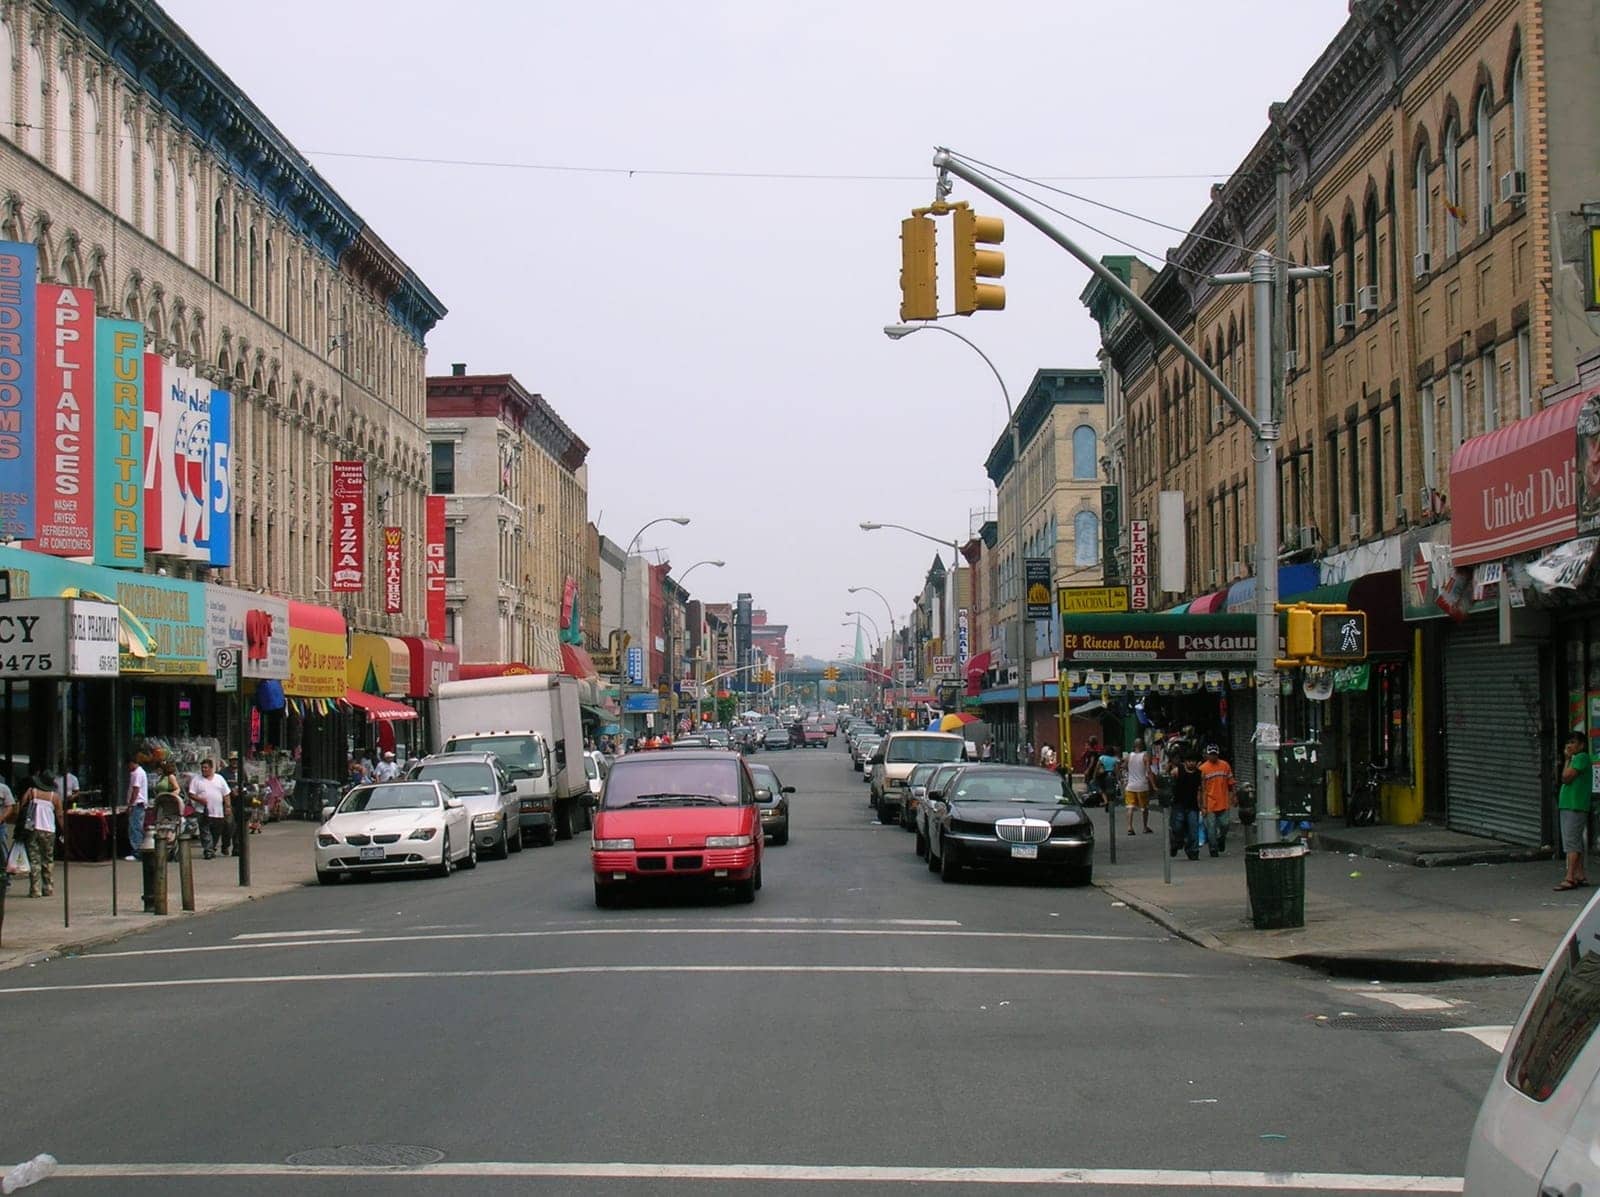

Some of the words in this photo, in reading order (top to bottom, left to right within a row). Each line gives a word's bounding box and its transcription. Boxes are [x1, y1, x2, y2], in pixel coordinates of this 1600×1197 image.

[55, 288, 80, 495] APPLIANCES
[113, 331, 139, 559] FURNITURE
[1482, 473, 1535, 531] United
[1540, 456, 1576, 514] Deli
[41, 525, 89, 538] REFRIGERATORS
[338, 502, 358, 567] PIZZA
[387, 551, 401, 609] KITCHEN
[427, 544, 445, 591] GNC
[1132, 522, 1146, 609] LLAMADAS
[1065, 635, 1077, 649] El
[1083, 635, 1120, 649] Rincon
[1124, 635, 1165, 649] Dorado
